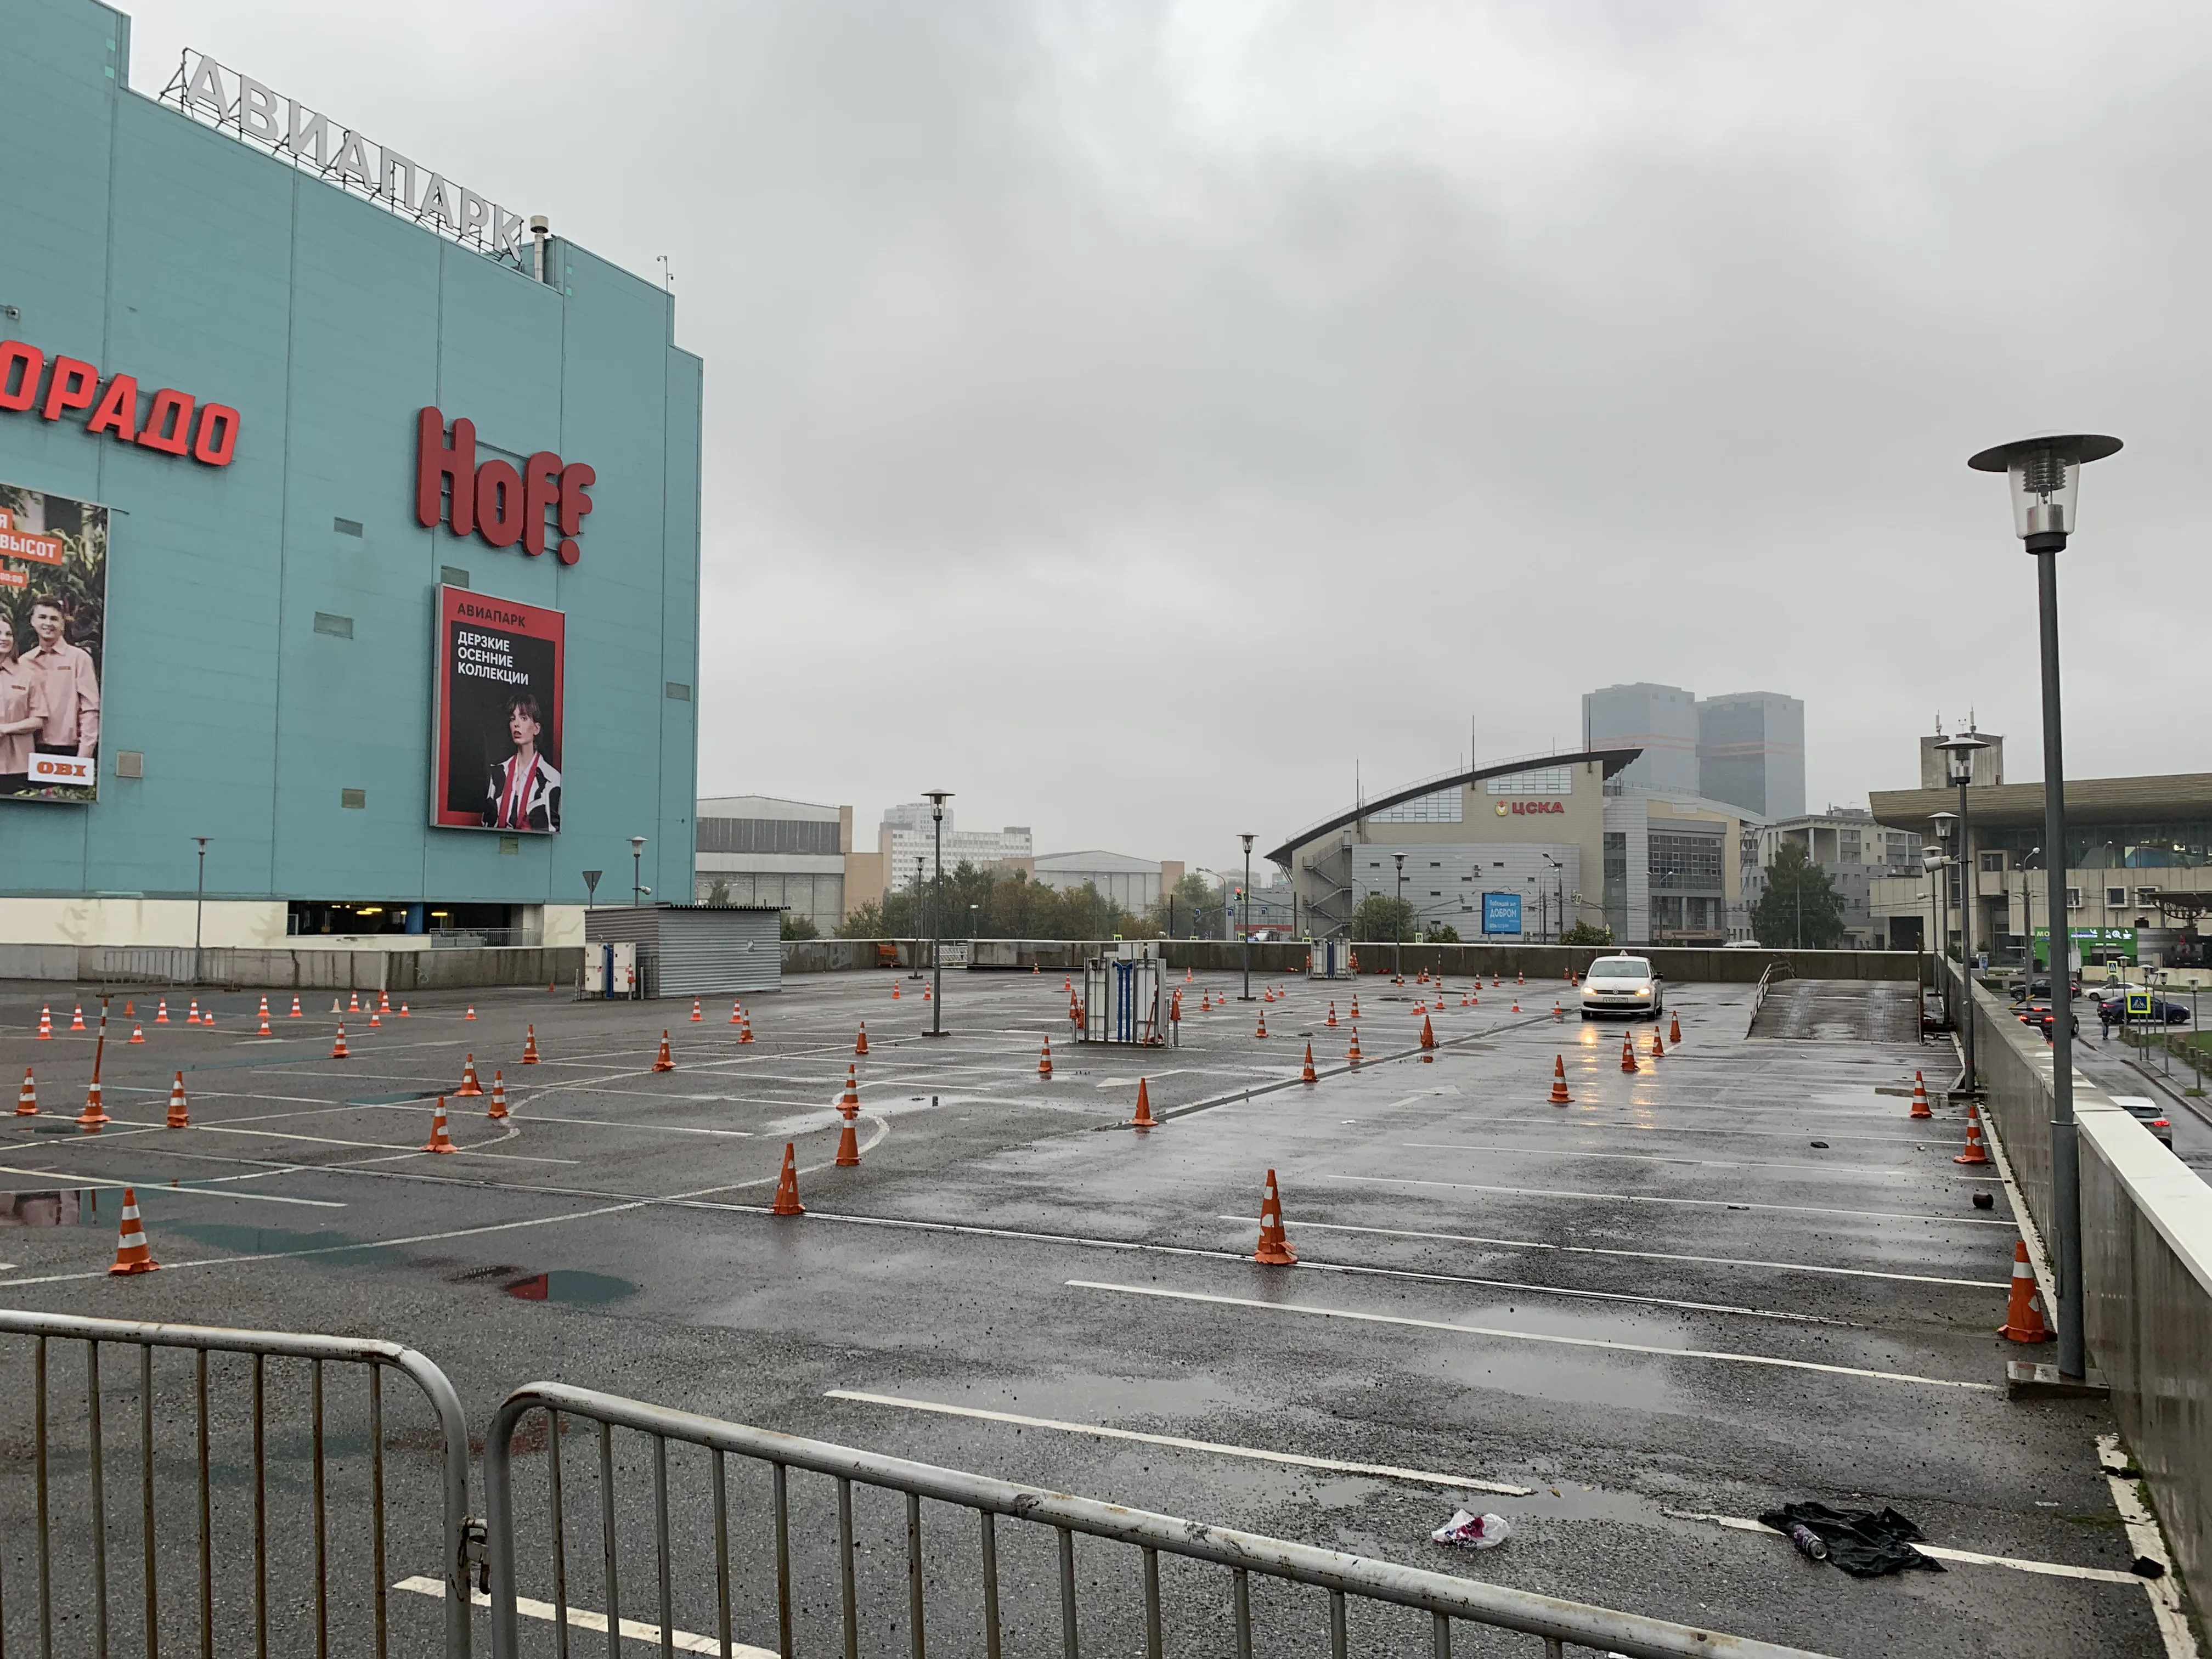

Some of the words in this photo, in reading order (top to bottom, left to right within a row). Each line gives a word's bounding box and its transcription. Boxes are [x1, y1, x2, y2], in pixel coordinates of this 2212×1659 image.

[186, 55, 522, 263] АВИАПАРК
[0, 340, 240, 466] ОРАДО
[0, 534, 57, 558] ВЫСОТ
[457, 603, 526, 628] АВИАПАРК
[458, 631, 510, 652] ДЕРЗКИЕ
[458, 646, 513, 668] ОСЕННИЕ
[458, 662, 528, 685] КОЛЛЕКЦИИ
[37, 761, 86, 777] OBI
[1512, 802, 1564, 815] ЦСКА
[1489, 908, 1516, 918] ДОБРОМ
